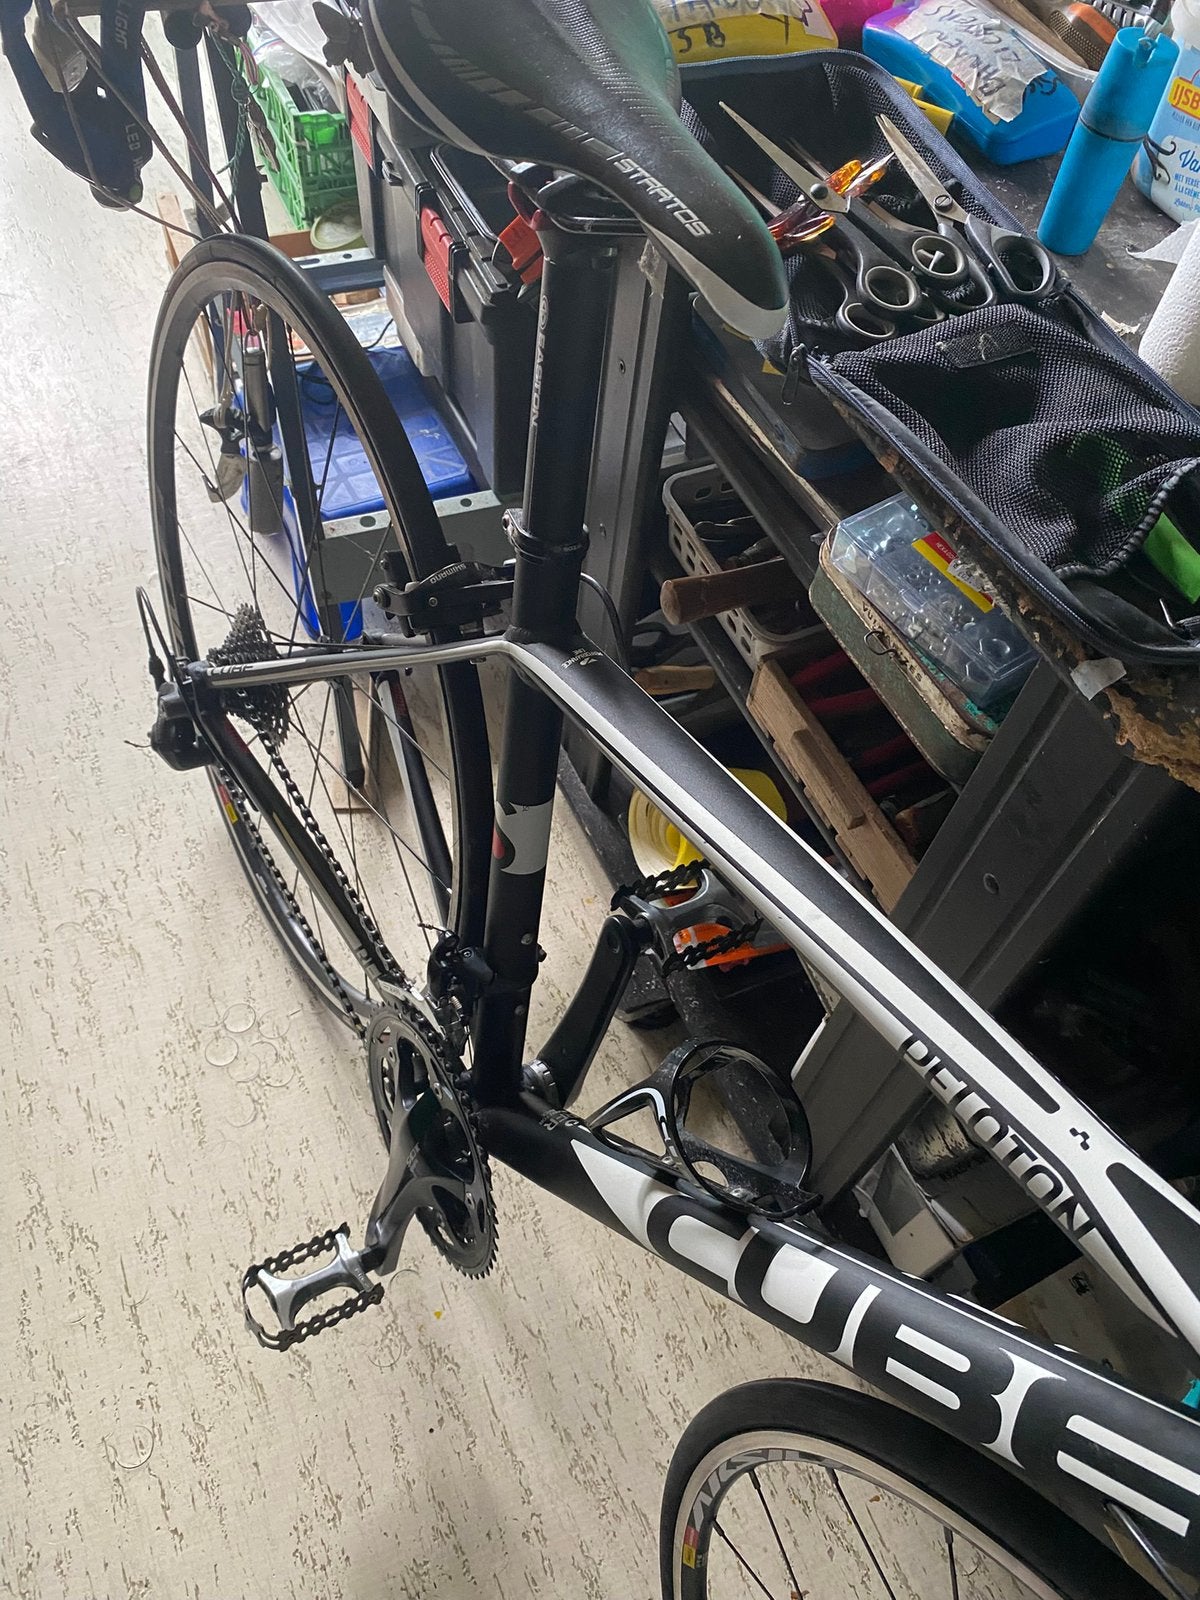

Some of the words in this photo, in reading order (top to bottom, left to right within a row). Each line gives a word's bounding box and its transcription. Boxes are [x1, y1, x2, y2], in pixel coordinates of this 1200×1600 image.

[613, 158, 712, 238] STRATOS
[529, 331, 546, 428] EASTON
[429, 562, 467, 585] SHIMANO
[899, 1034, 1096, 1239] PELOTON
[646, 1193, 1200, 1560] CUBE
